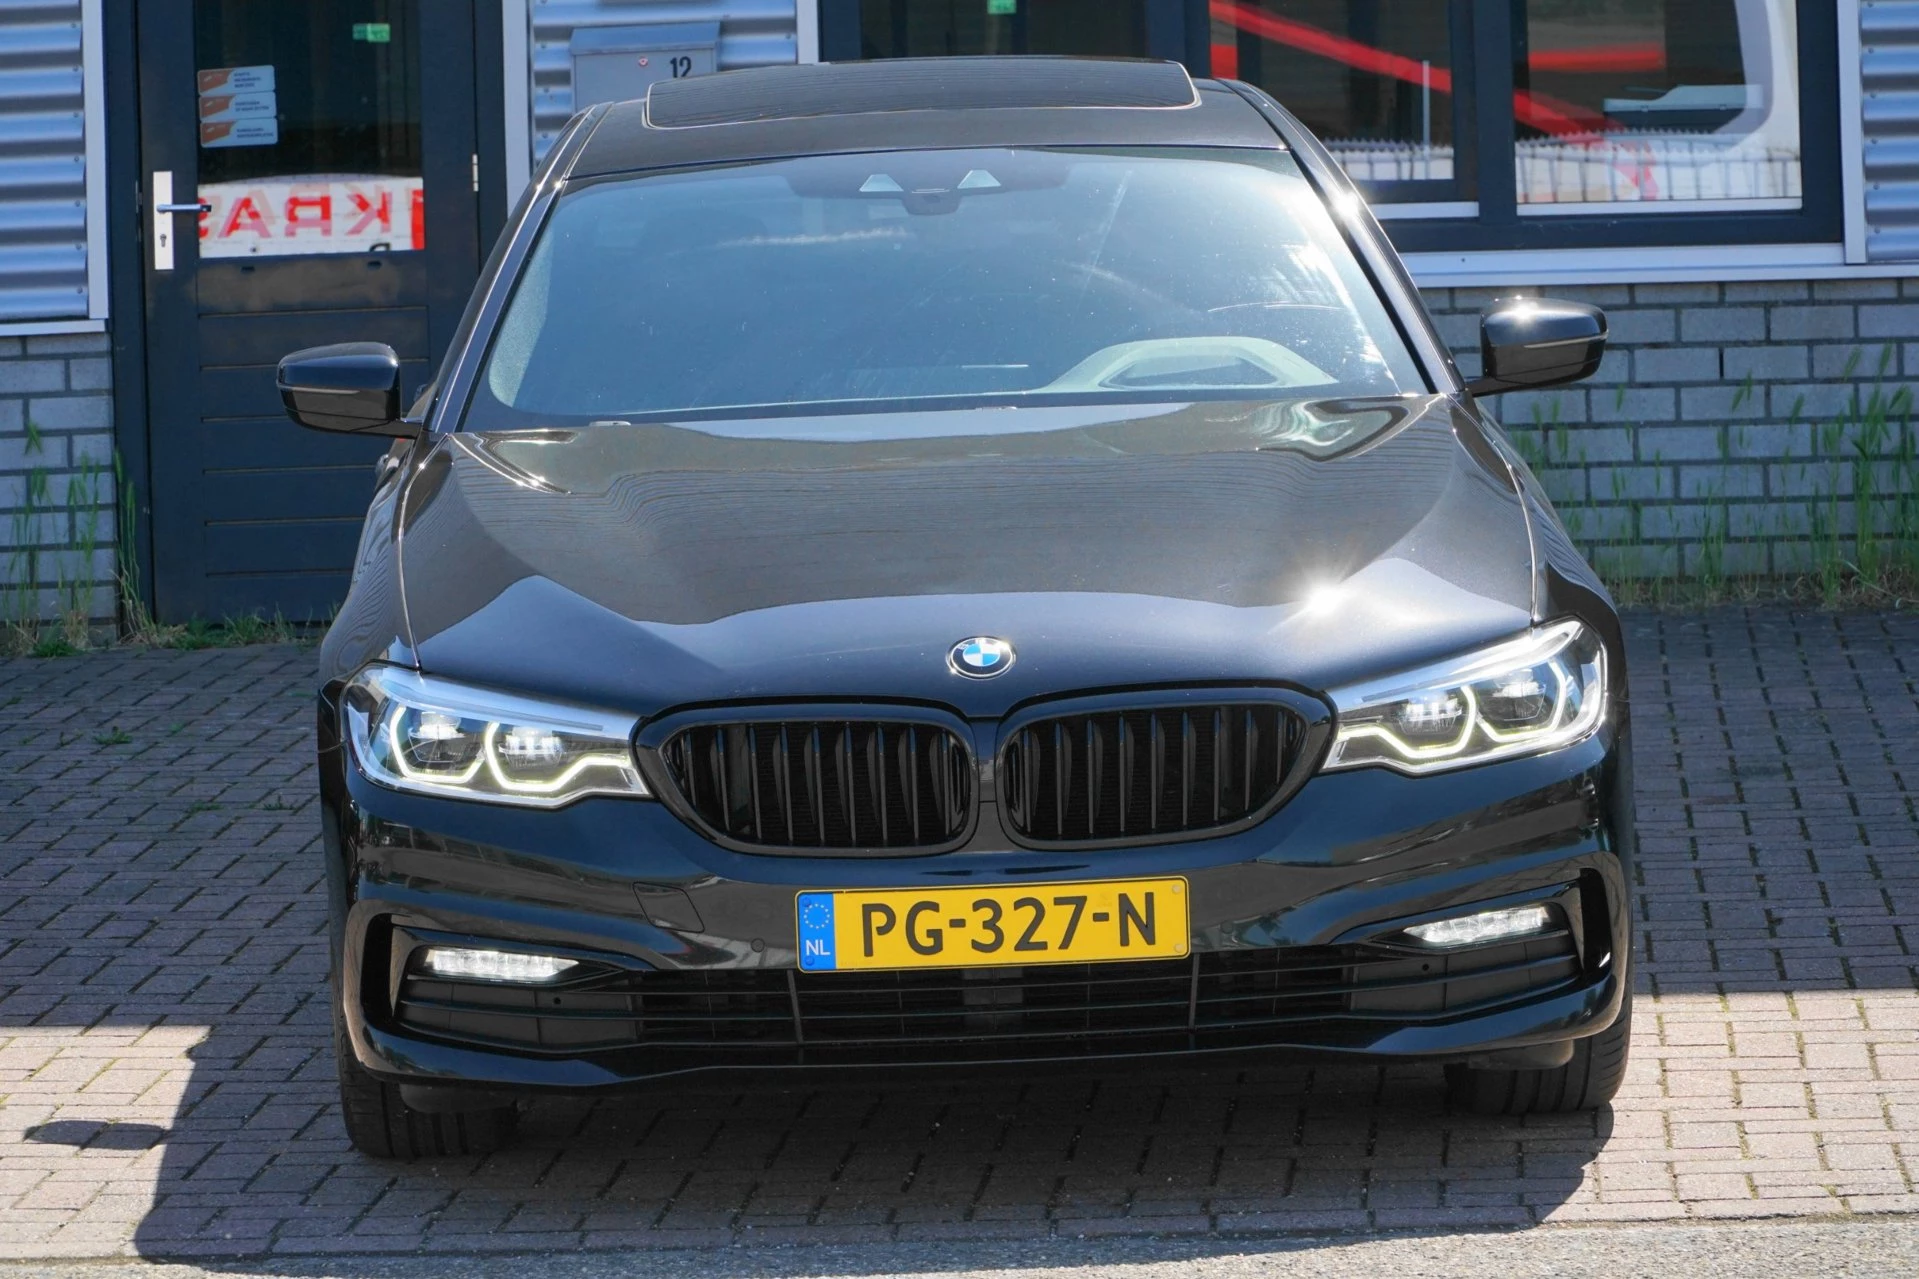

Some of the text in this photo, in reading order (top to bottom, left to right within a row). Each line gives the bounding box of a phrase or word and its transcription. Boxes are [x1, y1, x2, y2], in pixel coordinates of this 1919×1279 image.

[670, 56, 691, 78] 12
[861, 892, 1156, 957] PG-327-N
[805, 939, 831, 956] NL
